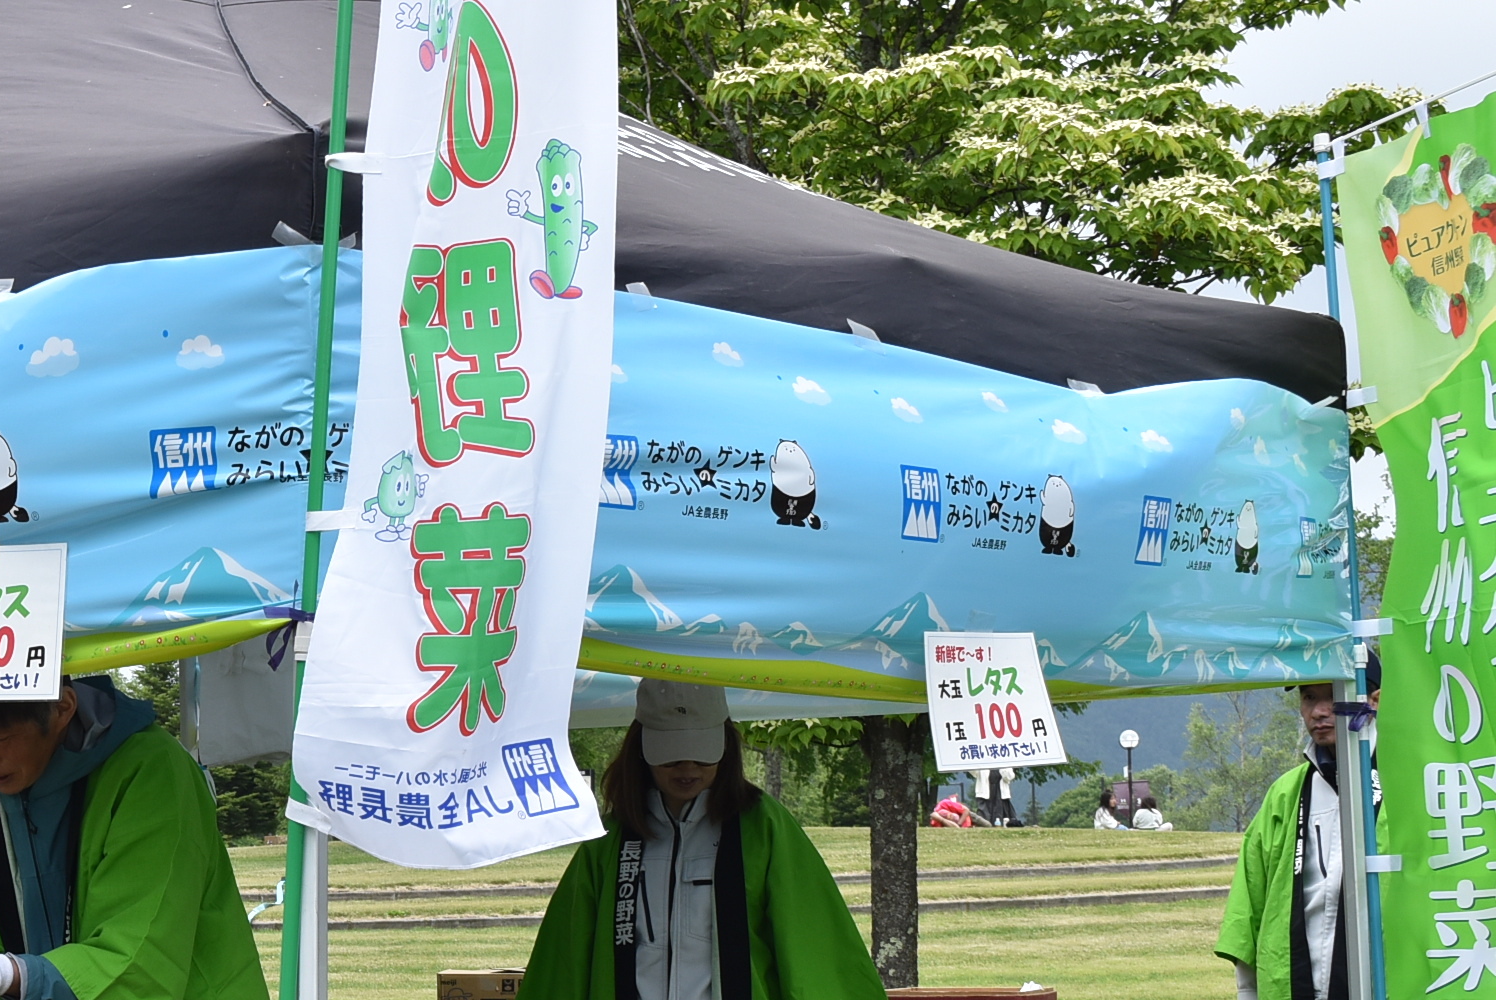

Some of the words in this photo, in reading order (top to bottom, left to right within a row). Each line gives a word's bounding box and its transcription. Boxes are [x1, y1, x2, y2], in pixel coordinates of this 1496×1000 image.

[153, 431, 214, 470] 信州
[227, 422, 305, 453] ながの
[604, 438, 636, 470] 信州
[647, 438, 702, 465] ながの
[716, 445, 766, 471] ゲンキ
[226, 459, 303, 487] みらい
[640, 470, 701, 496] みらい
[717, 477, 767, 503] ミカタ
[904, 470, 939, 503] 信州
[945, 472, 988, 497] ながの
[999, 480, 1037, 504] ゲンキ
[682, 504, 729, 521] JA全農長野
[947, 504, 987, 529] みらい
[1000, 511, 1037, 534] ミカタ
[1143, 500, 1170, 530] 信州
[1174, 501, 1204, 523] ながの
[1210, 506, 1235, 528] ゲンキ
[971, 537, 1007, 551] JA全農長野
[1169, 530, 1200, 553] みらい
[1208, 535, 1233, 556] ミカタ
[26, 645, 45, 667] 円
[938, 679, 963, 699] 大玉
[966, 667, 1023, 696] レタス
[945, 721, 967, 741] 1玉
[974, 702, 1022, 739] 100
[1031, 718, 1047, 737] 円
[959, 741, 1048, 760] お買い求め下さい！
[615, 840, 642, 946] 長野の野菜
